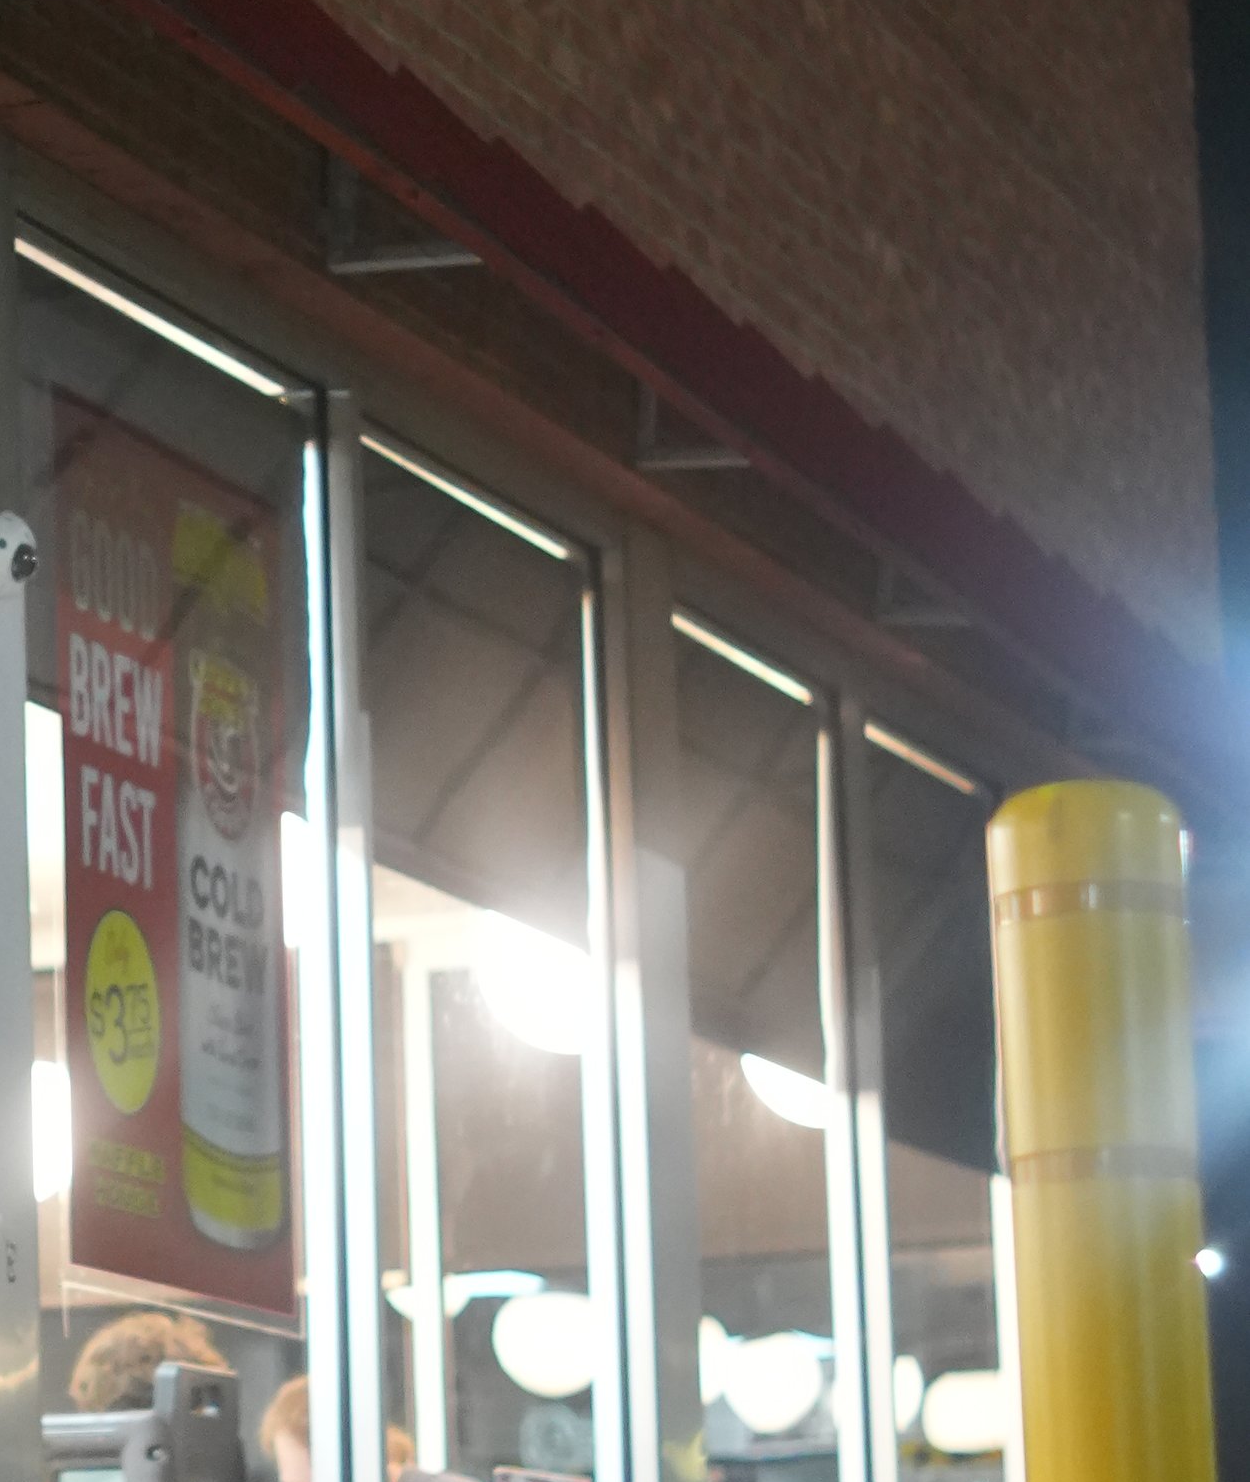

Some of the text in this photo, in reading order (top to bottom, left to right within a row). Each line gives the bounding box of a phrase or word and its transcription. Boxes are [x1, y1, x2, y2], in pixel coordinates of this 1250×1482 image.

[70, 510, 157, 642] GOOD
[70, 634, 162, 767] BREW
[81, 766, 155, 890] FAST
[190, 855, 265, 927] COLD
[187, 919, 267, 995] BREW
